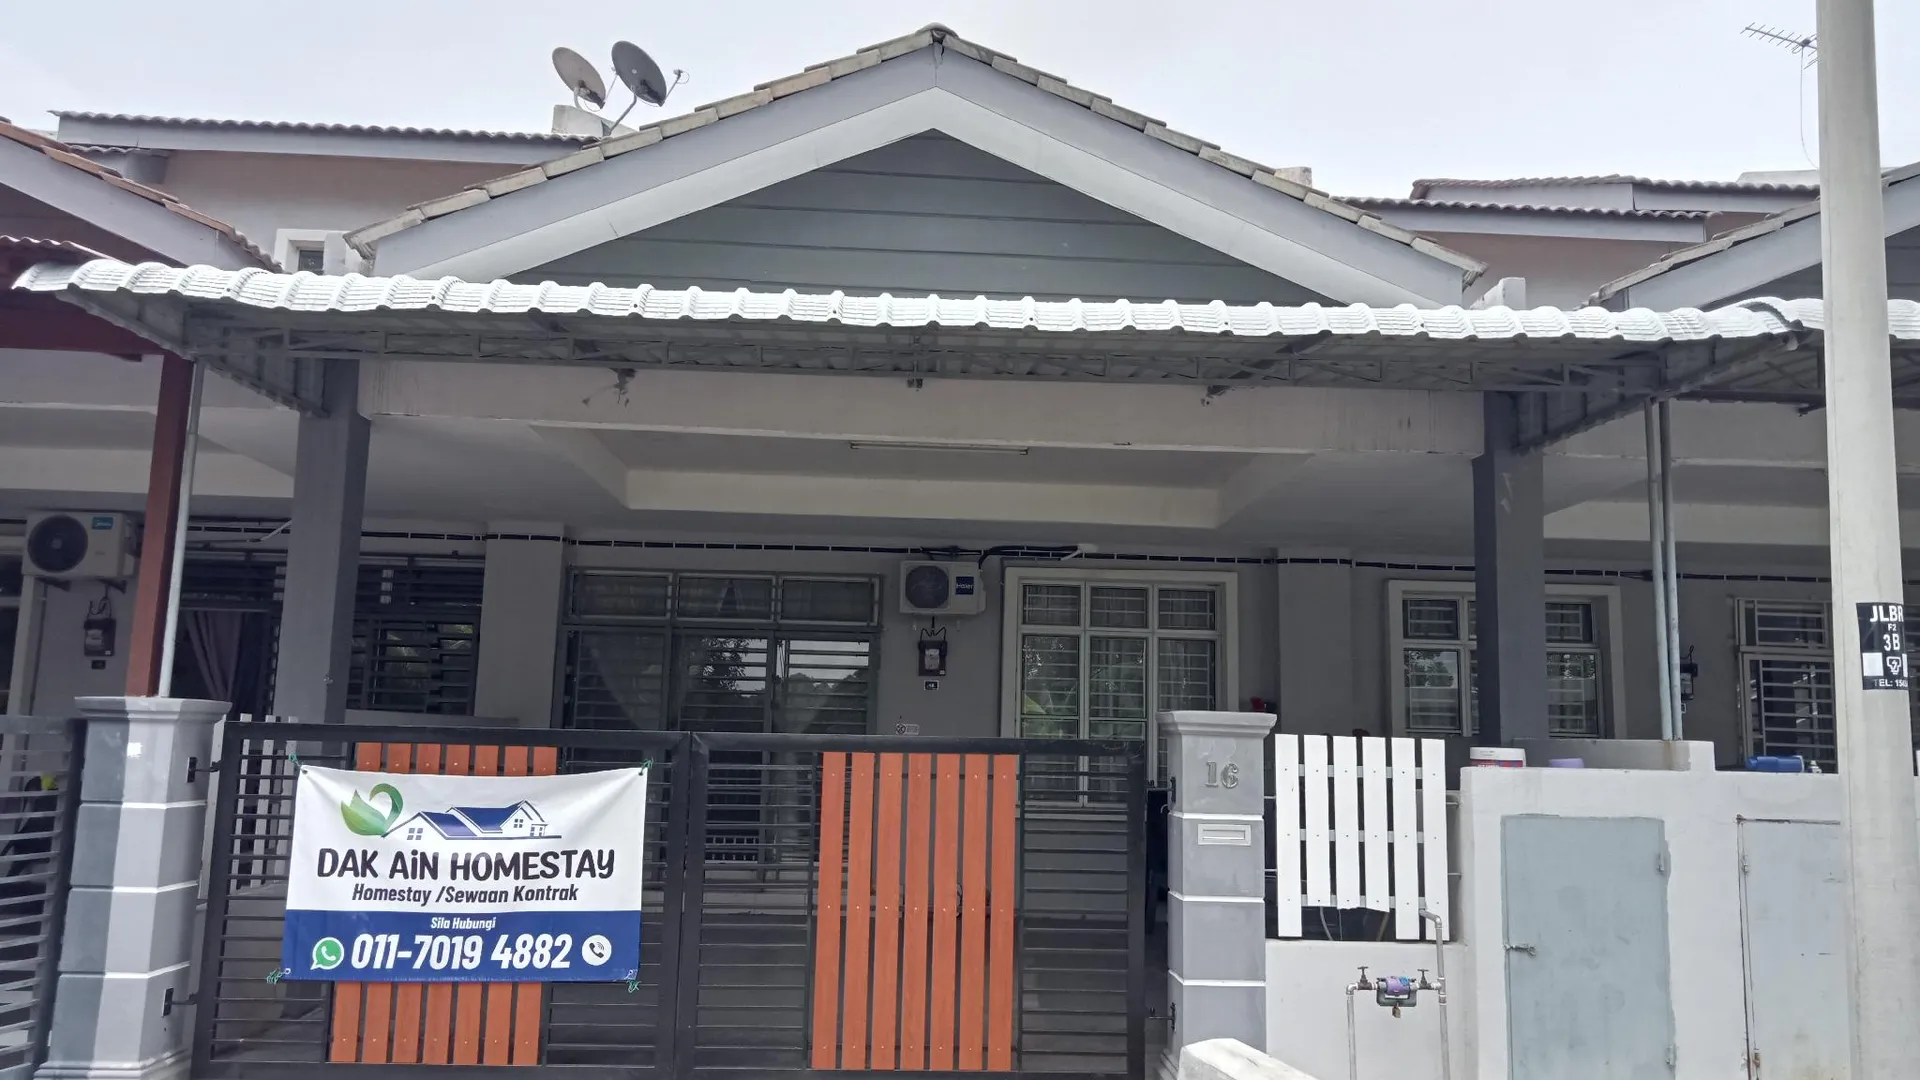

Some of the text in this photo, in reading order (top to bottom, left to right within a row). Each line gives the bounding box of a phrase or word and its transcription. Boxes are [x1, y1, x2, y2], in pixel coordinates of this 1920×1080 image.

[1869, 605, 1904, 622] JLBR
[1205, 761, 1239, 789] 16
[317, 848, 378, 878] DAK
[451, 848, 615, 881] HOMESTAY
[352, 884, 431, 907] Homestay
[513, 885, 579, 902] Kontrak
[430, 916, 496, 931] Sila Hubungi
[351, 933, 573, 970] 011-7019 4882
